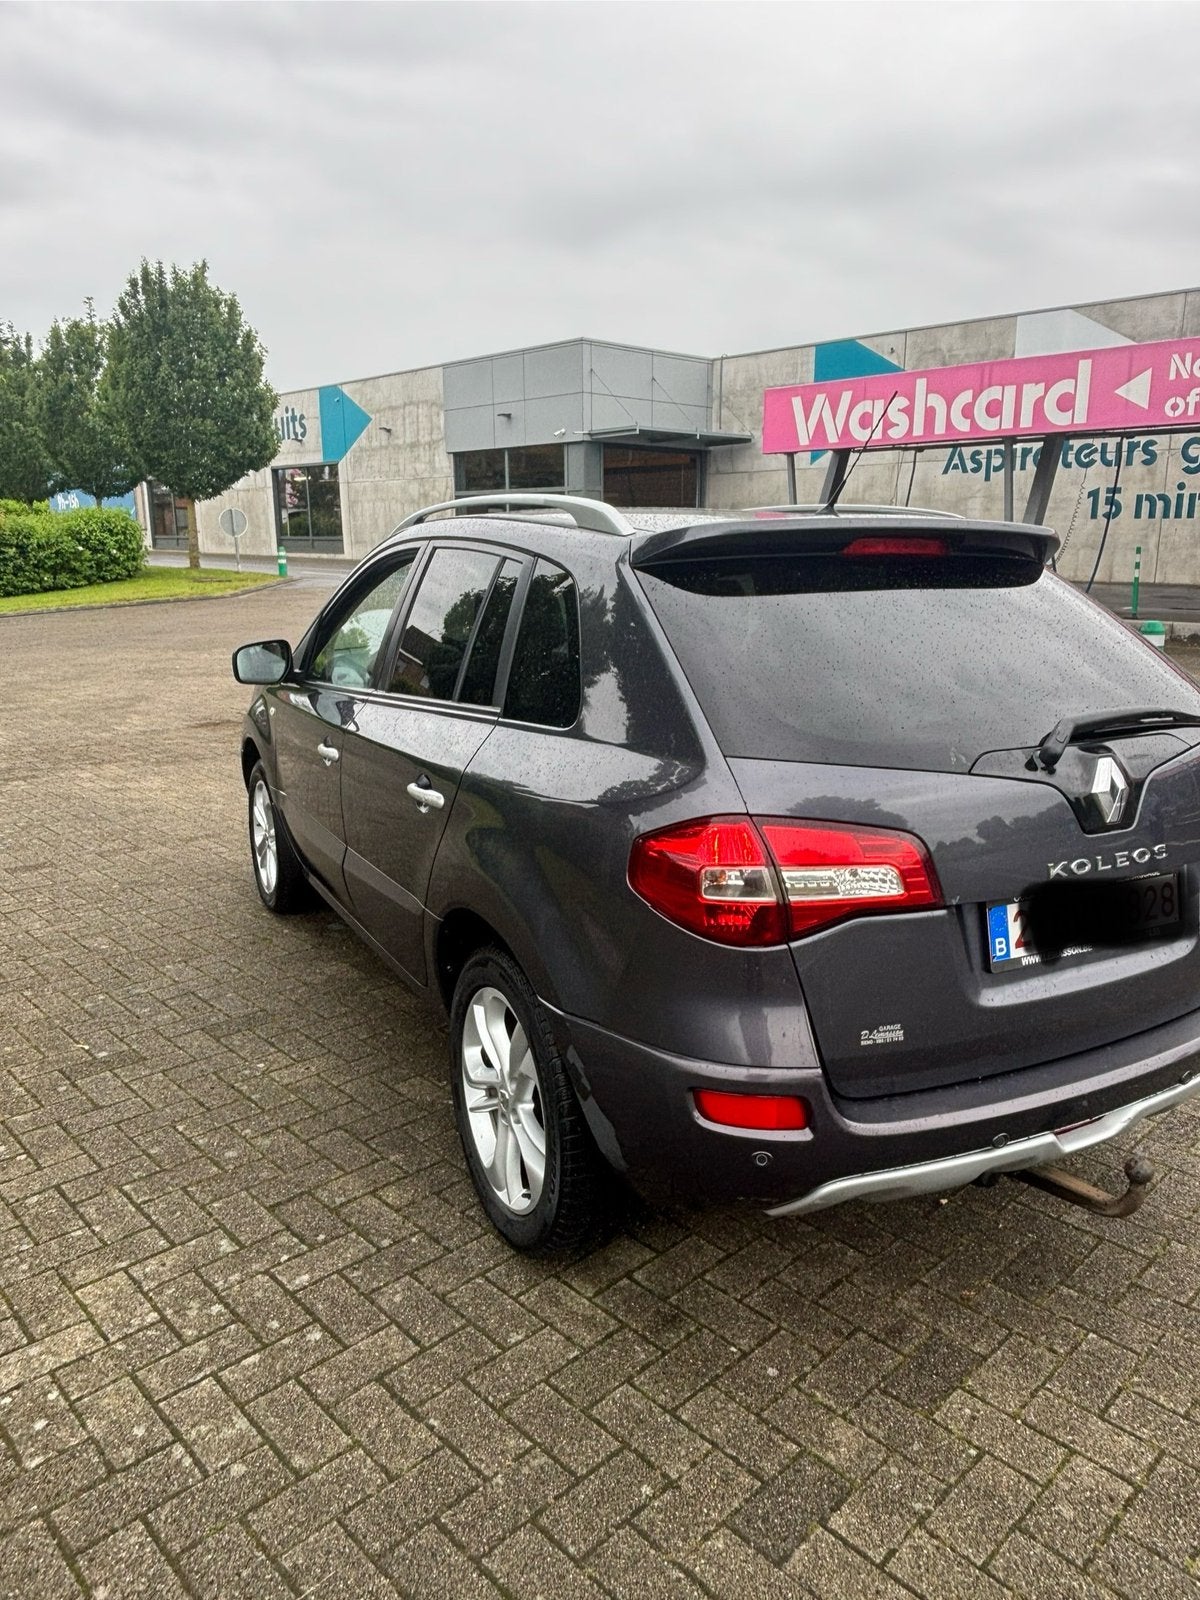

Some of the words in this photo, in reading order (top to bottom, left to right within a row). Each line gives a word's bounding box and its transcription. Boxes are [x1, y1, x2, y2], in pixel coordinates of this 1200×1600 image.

[792, 359, 1093, 446] Washcard
[1087, 486, 1122, 520] 15
[1047, 844, 1169, 879] KOLEOS
[995, 937, 1007, 957] B
